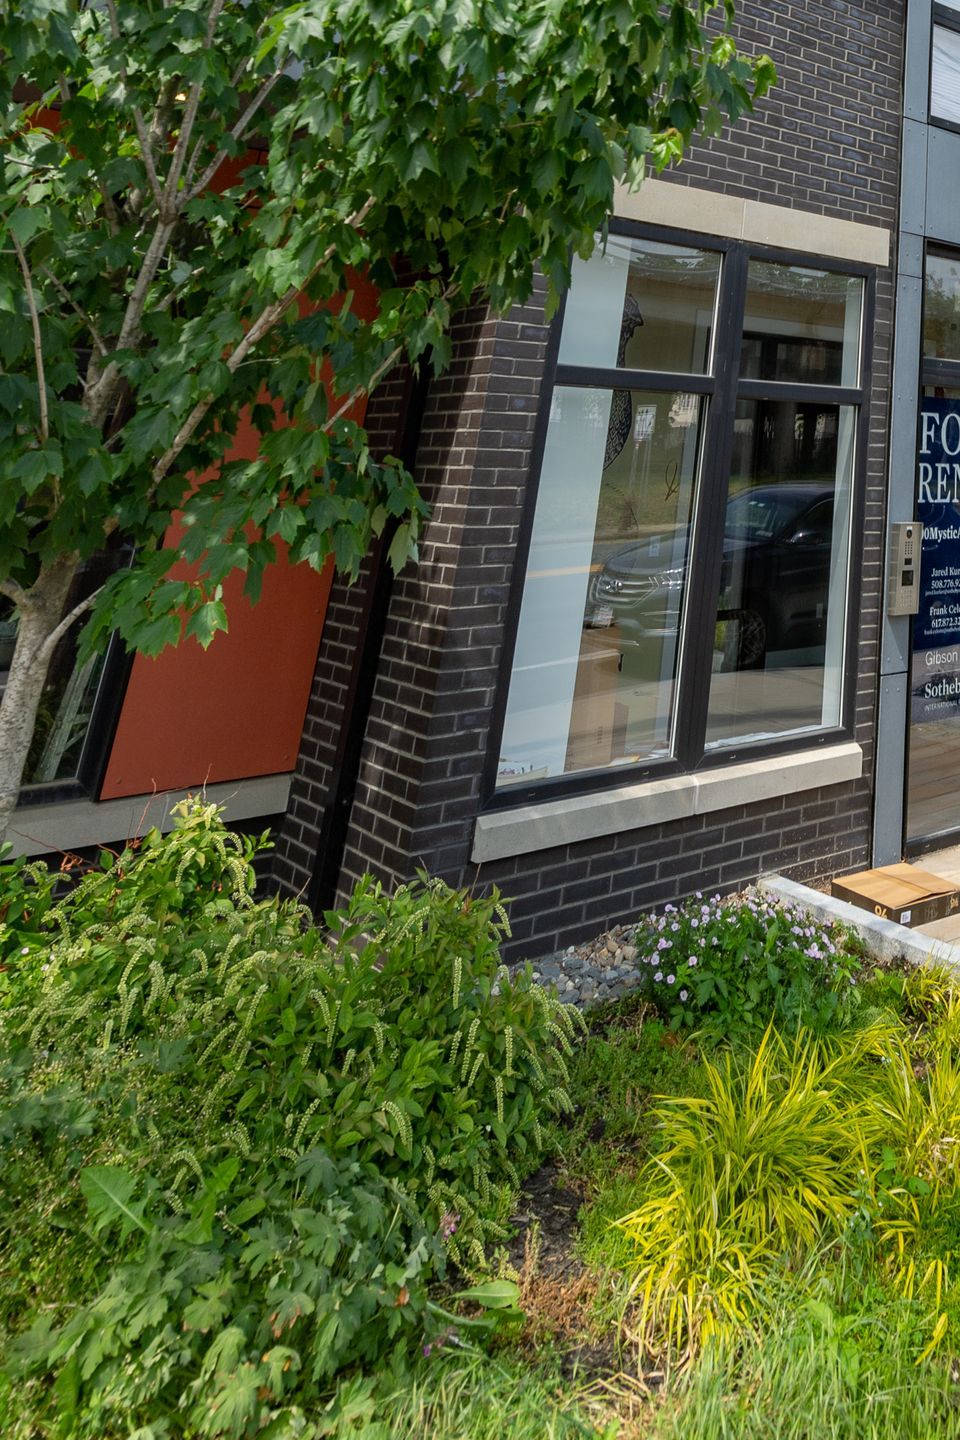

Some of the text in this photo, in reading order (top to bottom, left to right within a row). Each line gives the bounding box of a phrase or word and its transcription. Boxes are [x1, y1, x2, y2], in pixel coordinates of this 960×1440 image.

[931, 566, 948, 577] Jared
[929, 604, 948, 616] Frank
[925, 651, 958, 666] Gibson
